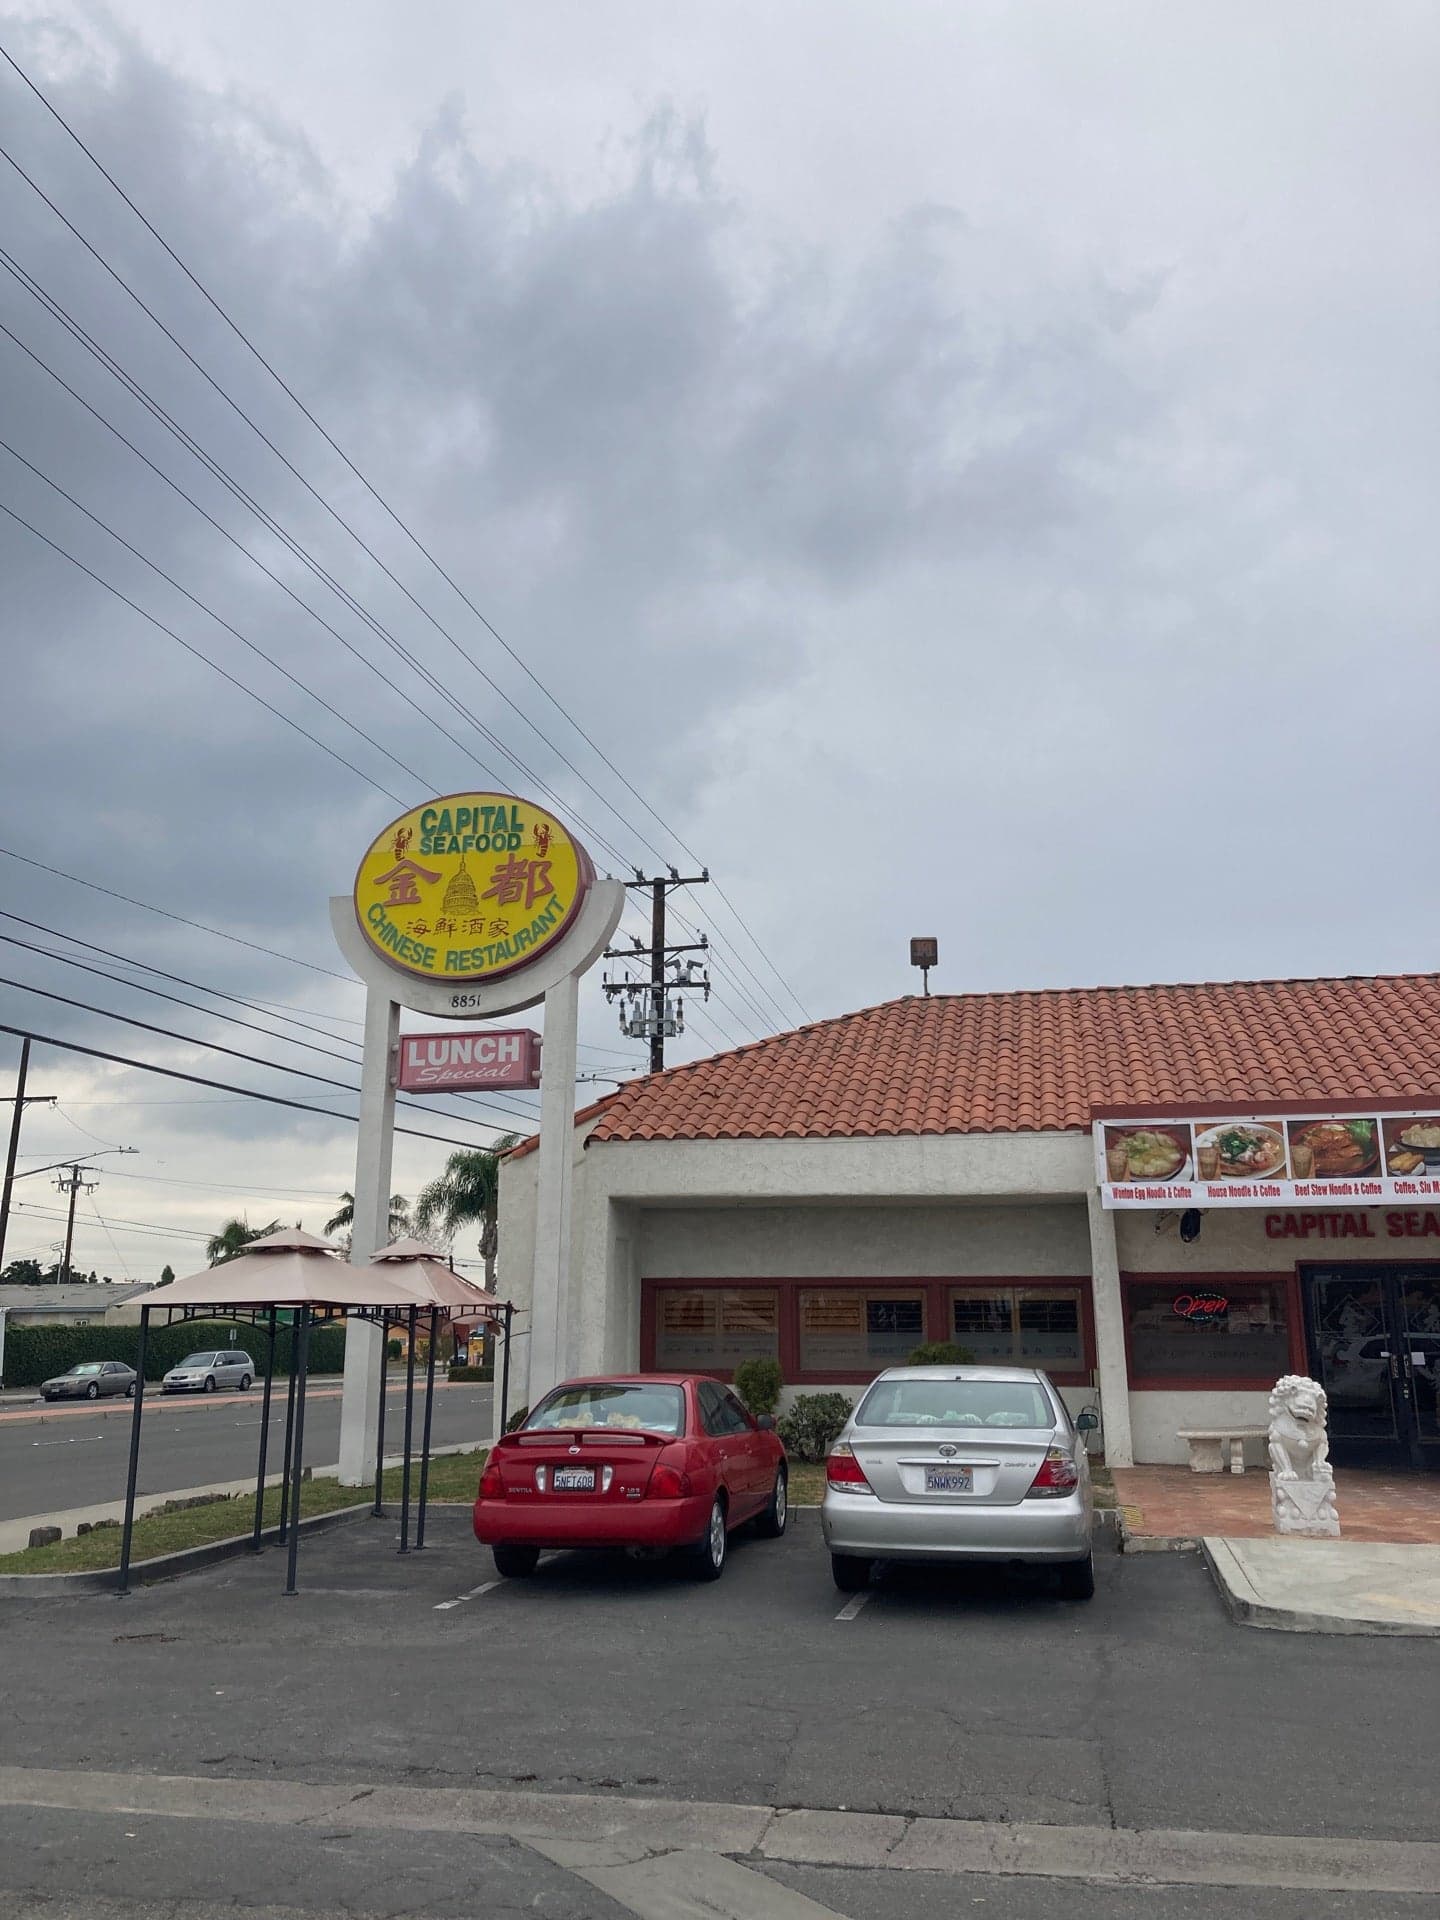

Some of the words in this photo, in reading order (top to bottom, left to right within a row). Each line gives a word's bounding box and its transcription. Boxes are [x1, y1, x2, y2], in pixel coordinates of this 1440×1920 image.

[420, 805, 524, 836] CAPITAL
[419, 832, 522, 856] SEAFOOD
[367, 902, 437, 970] CHINESE
[444, 894, 566, 972] RESTAURANT
[405, 917, 511, 938] 海鮮酒家
[450, 994, 482, 1009] 8851
[408, 1036, 521, 1067] LUNCH
[415, 1064, 512, 1083] Special
[1134, 1187, 1146, 1201] Egg
[1146, 1187, 1167, 1199] Noodle
[1167, 1186, 1173, 1198] &
[1173, 1186, 1192, 1198] Coffee
[1207, 1185, 1228, 1198] House
[1228, 1185, 1252, 1198] Noodle
[1253, 1185, 1259, 1197] &
[1260, 1184, 1281, 1197] Coffee
[1294, 1184, 1310, 1196] Beef
[1311, 1183, 1328, 1196] Stew
[1329, 1183, 1352, 1195] Noodle
[1354, 1183, 1360, 1195] &
[1360, 1182, 1382, 1195] Coffee
[1394, 1181, 1418, 1195] Coffee,
[1419, 1180, 1431, 1194] Siu
[1265, 1213, 1376, 1239] CAPITAL
[1173, 1295, 1228, 1316] Open
[927, 1476, 971, 1489] 5NWK992
